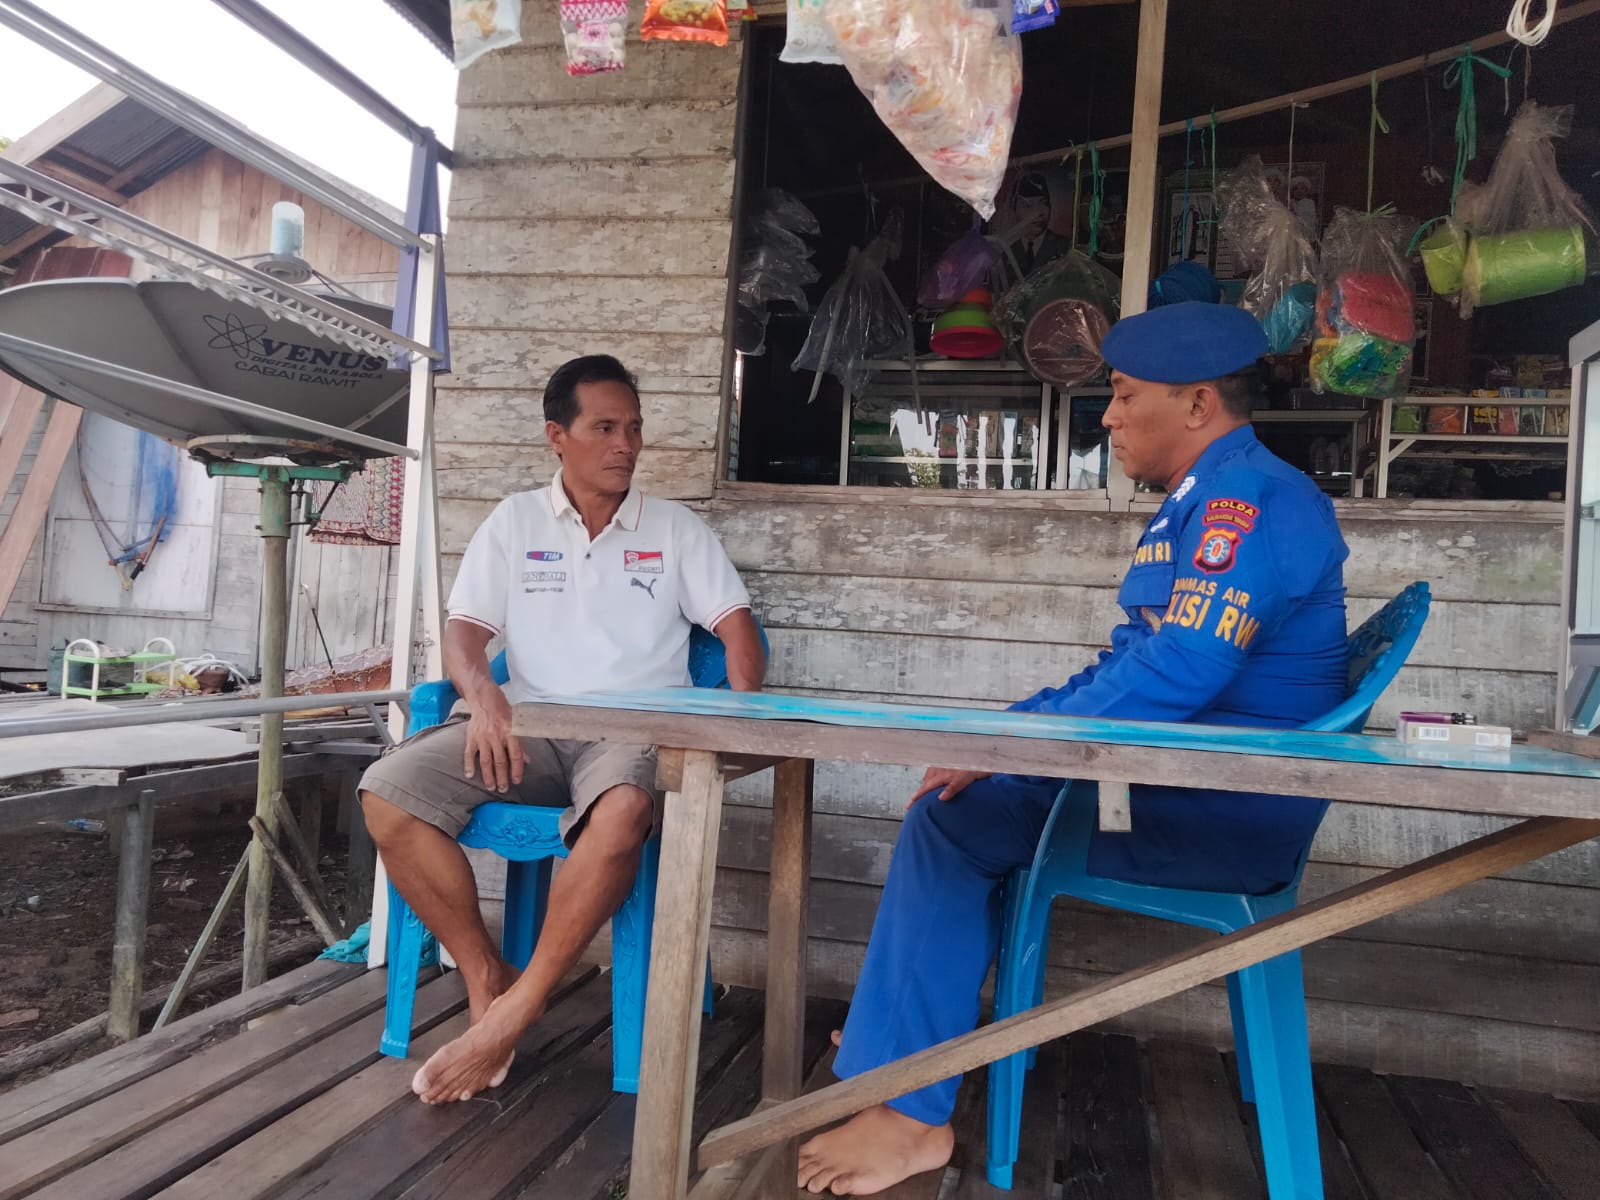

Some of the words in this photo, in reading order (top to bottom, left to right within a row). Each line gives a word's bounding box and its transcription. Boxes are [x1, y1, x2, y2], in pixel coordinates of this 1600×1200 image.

[251, 355, 308, 371] DIGITAL
[312, 366, 383, 380] PARABOLA
[261, 338, 386, 373] VENUS
[234, 360, 295, 380] CABAI
[299, 373, 361, 388] RAWIT
[1210, 500, 1256, 517] POLDA
[543, 551, 560, 561] TIM
[1222, 586, 1251, 609] AIR
[1215, 605, 1260, 650] RW
